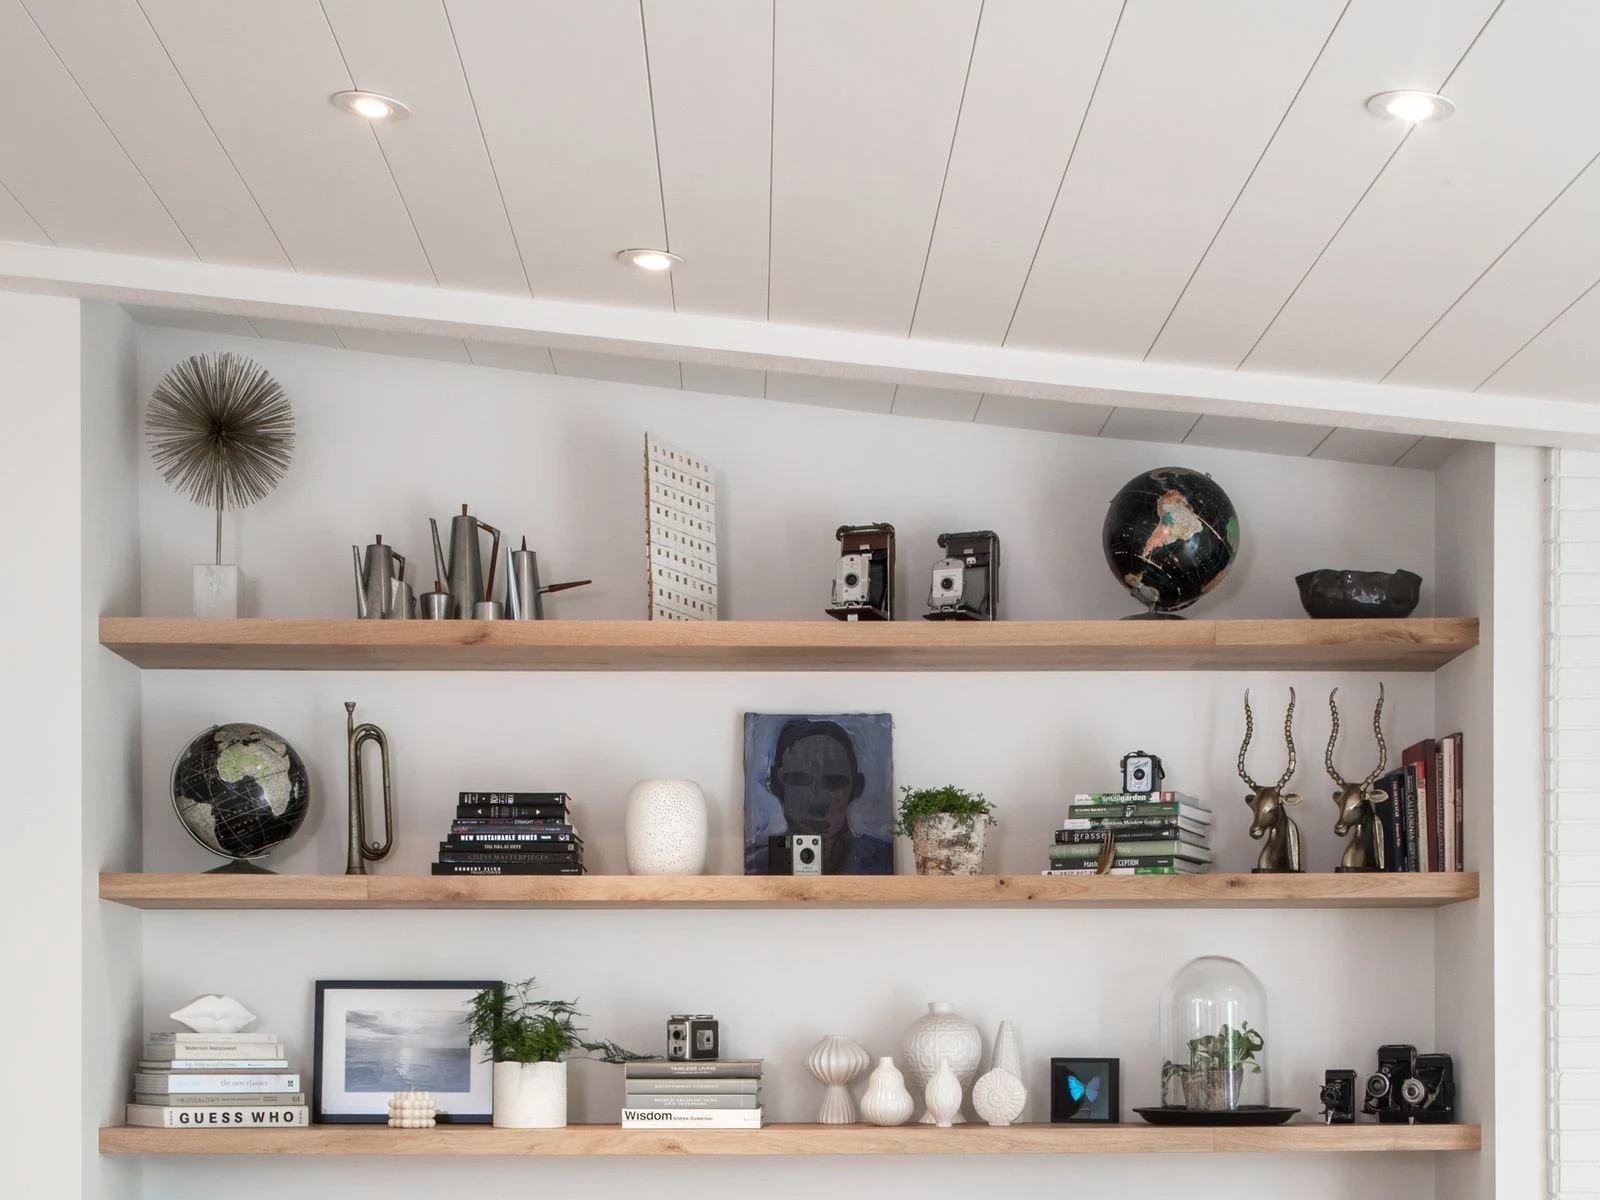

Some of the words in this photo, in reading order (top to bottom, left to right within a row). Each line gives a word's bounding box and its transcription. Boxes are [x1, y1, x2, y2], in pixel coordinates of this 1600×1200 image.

[179, 1112, 243, 1124] GUESS
[251, 1111, 294, 1123] WHO
[625, 1110, 672, 1121] Wisdom
